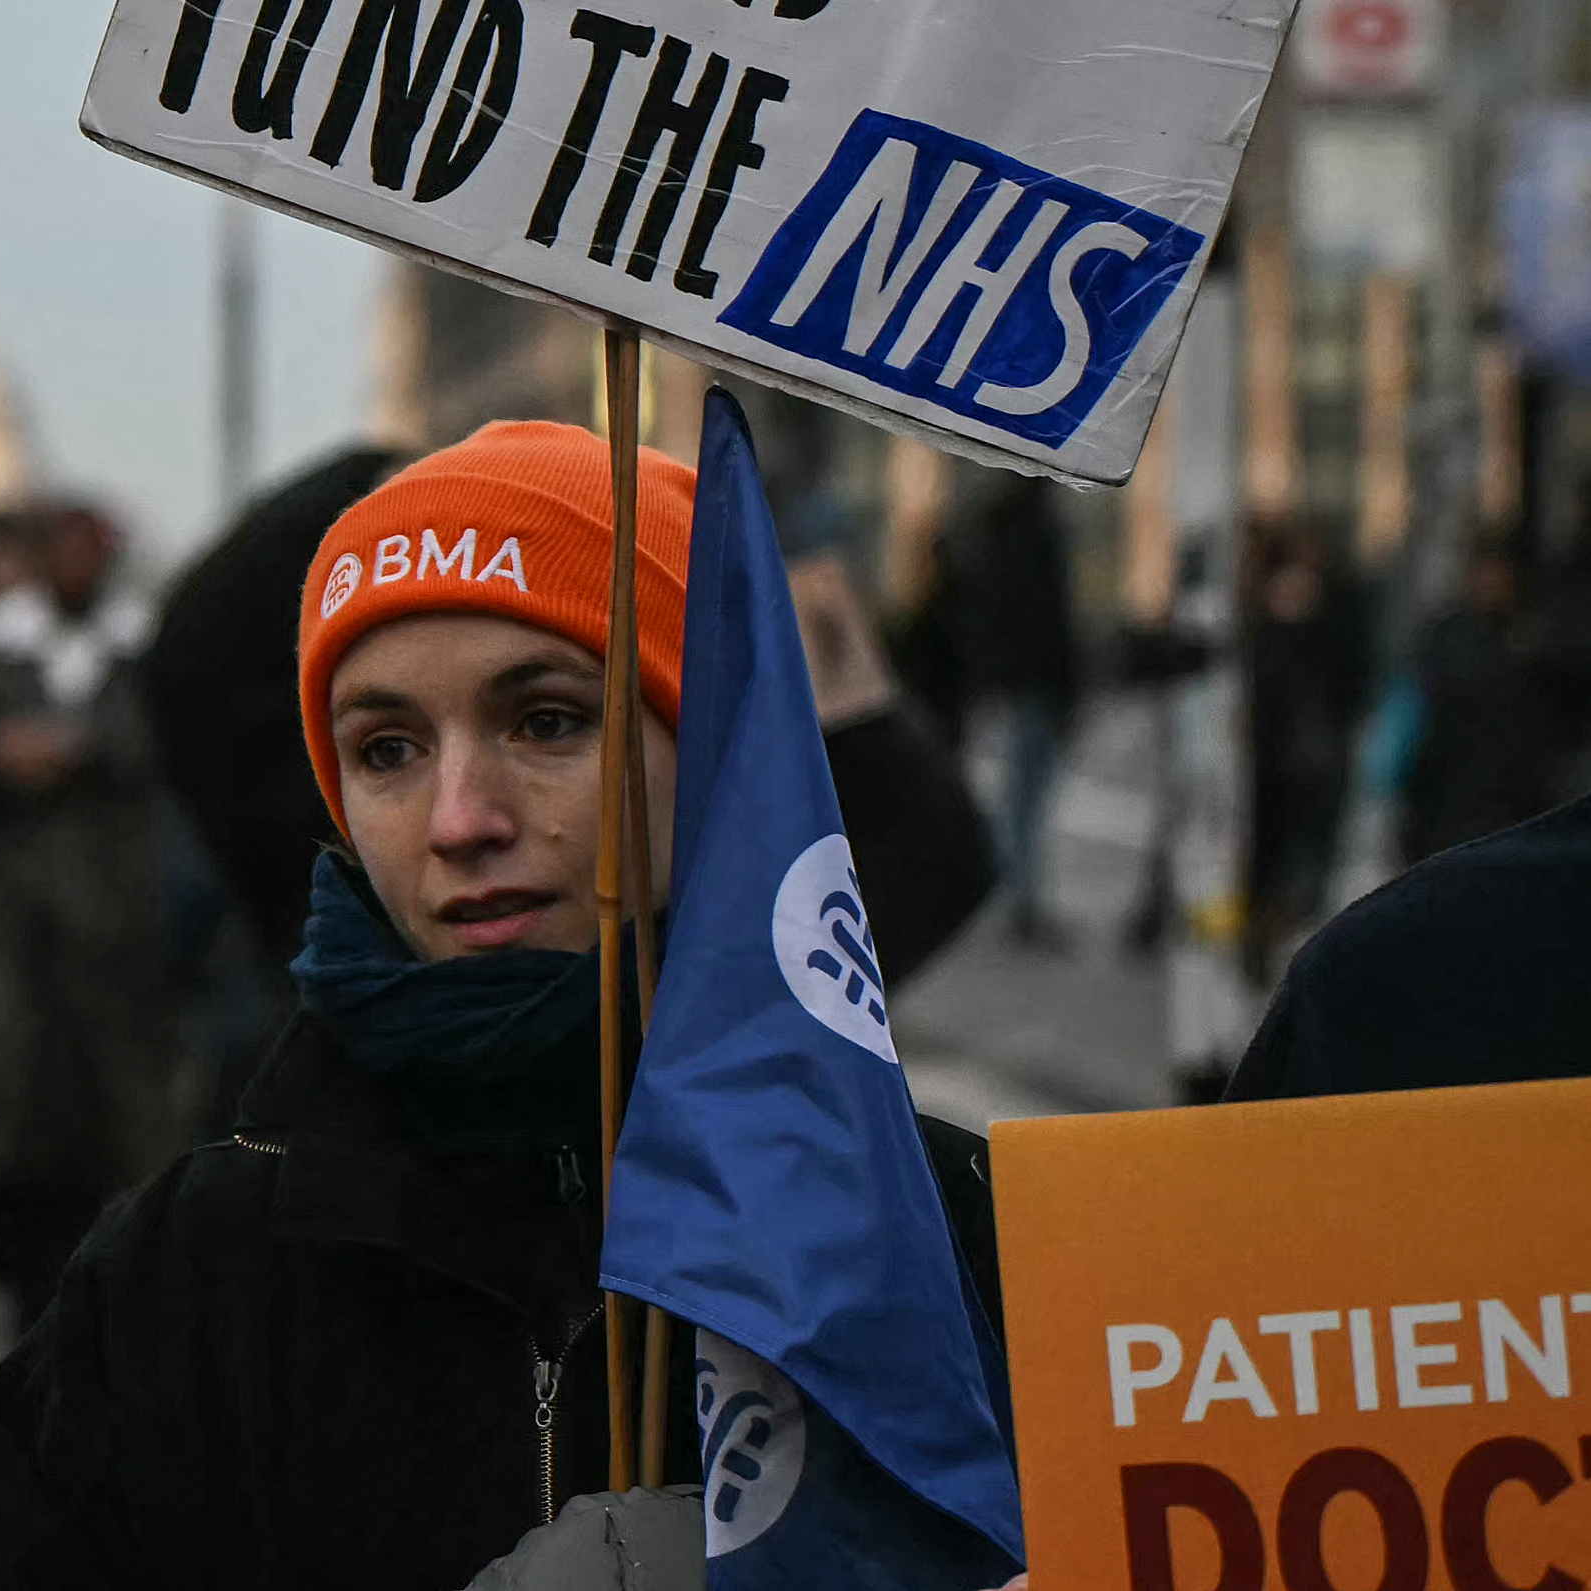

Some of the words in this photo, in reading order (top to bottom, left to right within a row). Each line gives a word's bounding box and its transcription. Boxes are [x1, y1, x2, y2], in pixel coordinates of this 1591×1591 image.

[525, 9, 789, 299] THE
[780, 138, 1149, 416] NHS
[373, 529, 528, 592] BMA
[1106, 1294, 1591, 1426] PATIEN
[1121, 1434, 1591, 1591] DOC
